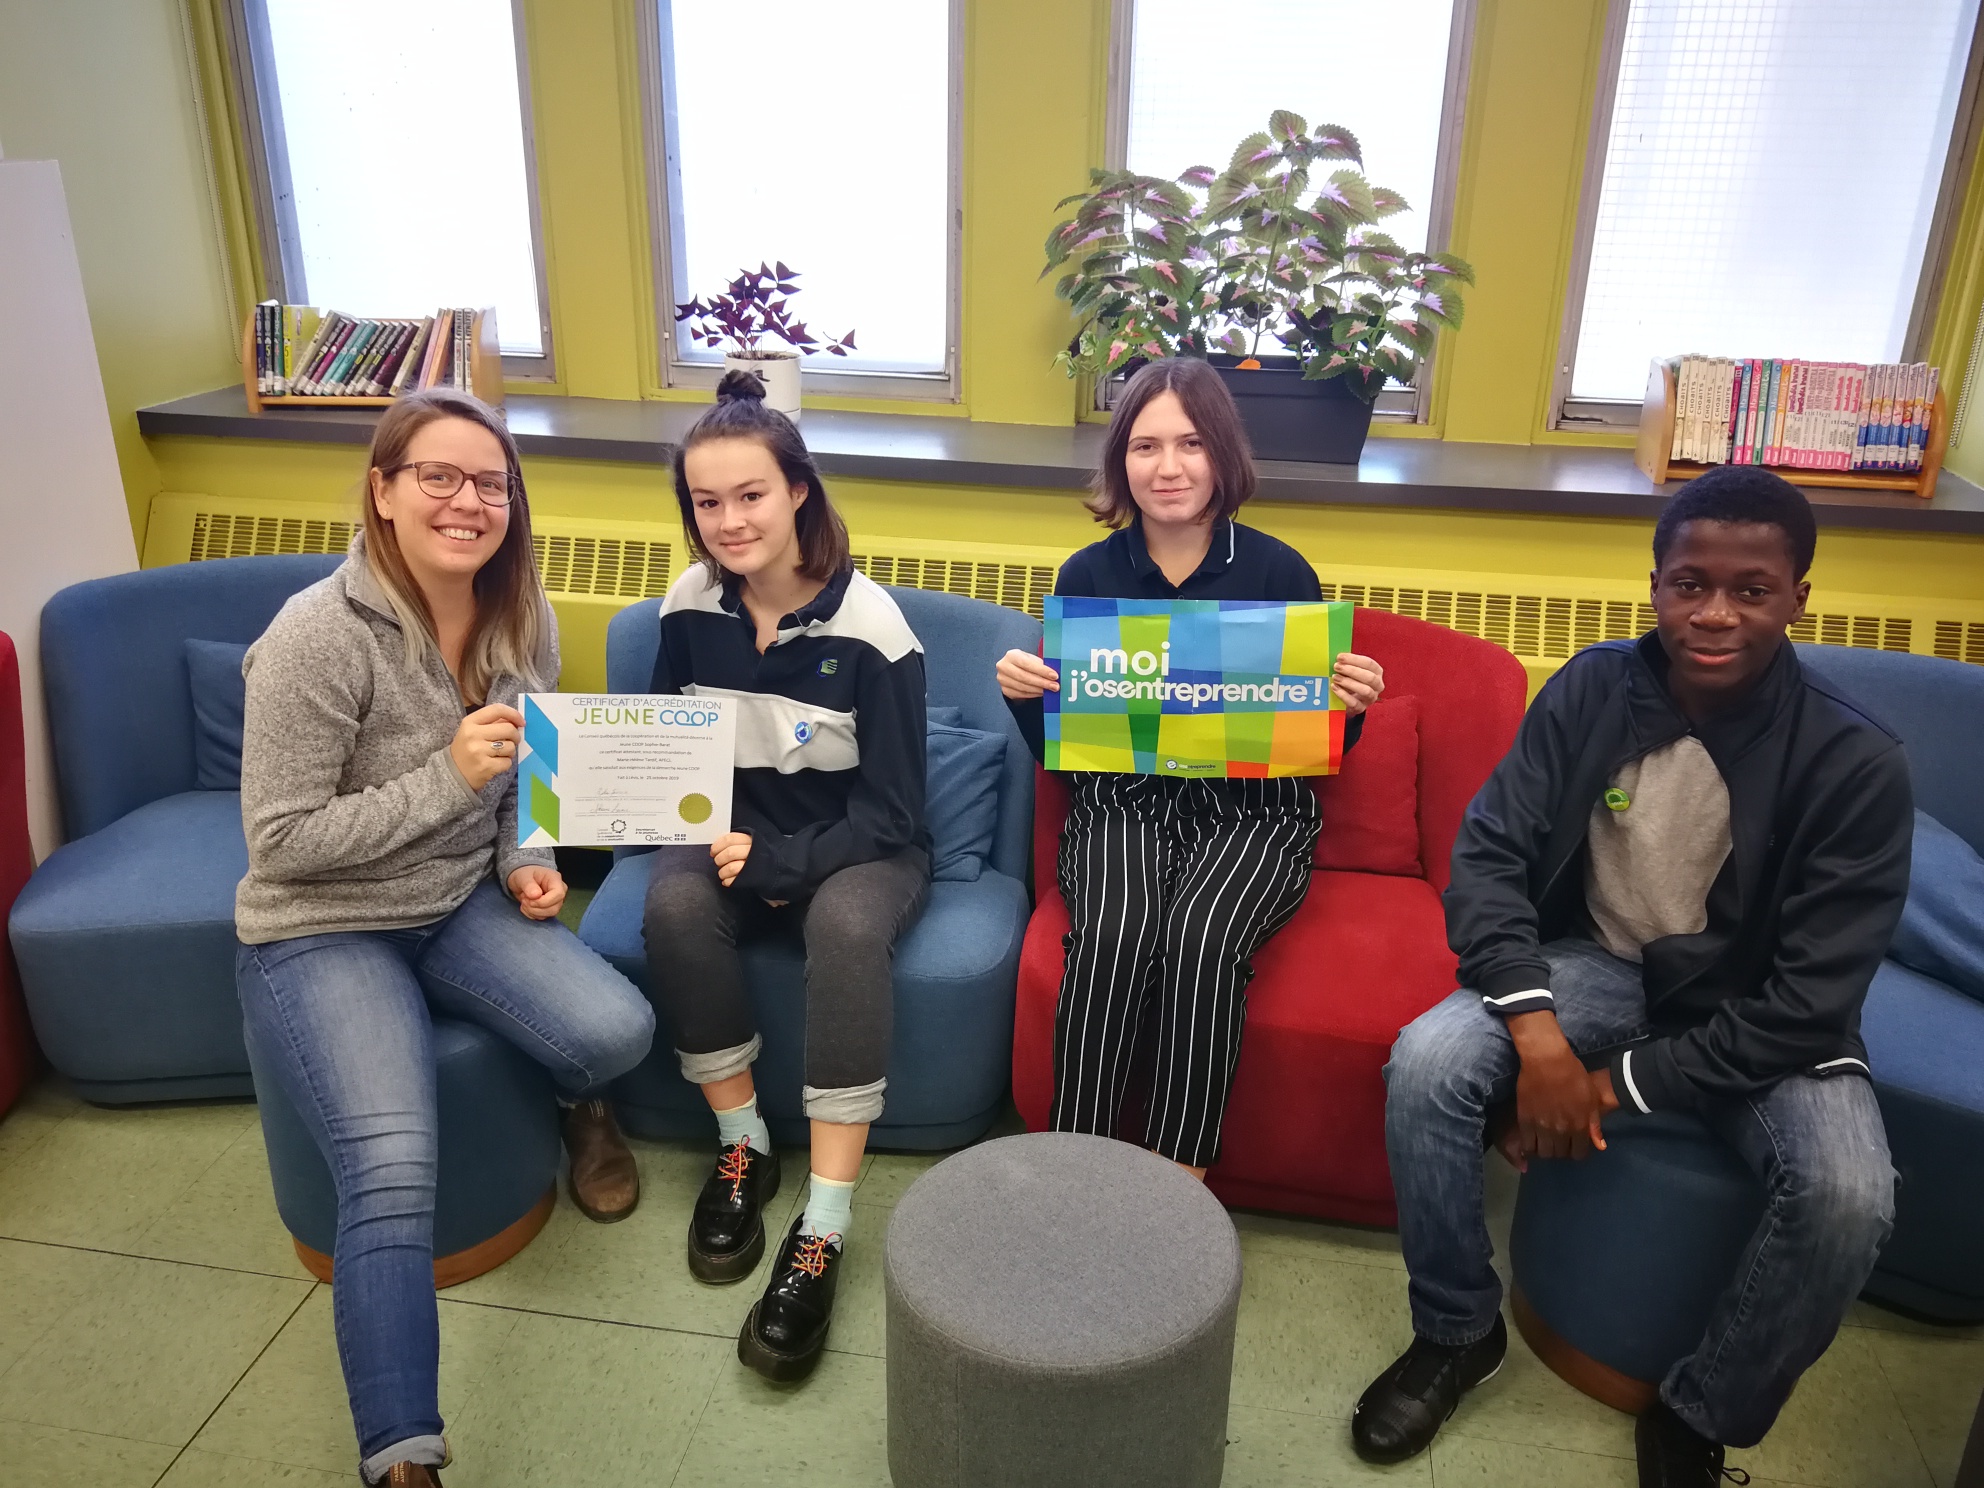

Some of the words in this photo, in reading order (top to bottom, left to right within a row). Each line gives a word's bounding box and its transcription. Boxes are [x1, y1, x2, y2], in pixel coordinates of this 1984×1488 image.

[1090, 641, 1170, 677] moi
[1068, 669, 1308, 708] j'osentreprendre
[572, 697, 630, 706] CERTIFICAT
[633, 698, 722, 710] D'ACCRÉDITATION
[574, 708, 654, 725] JEUNE
[659, 709, 719, 727] COOP
